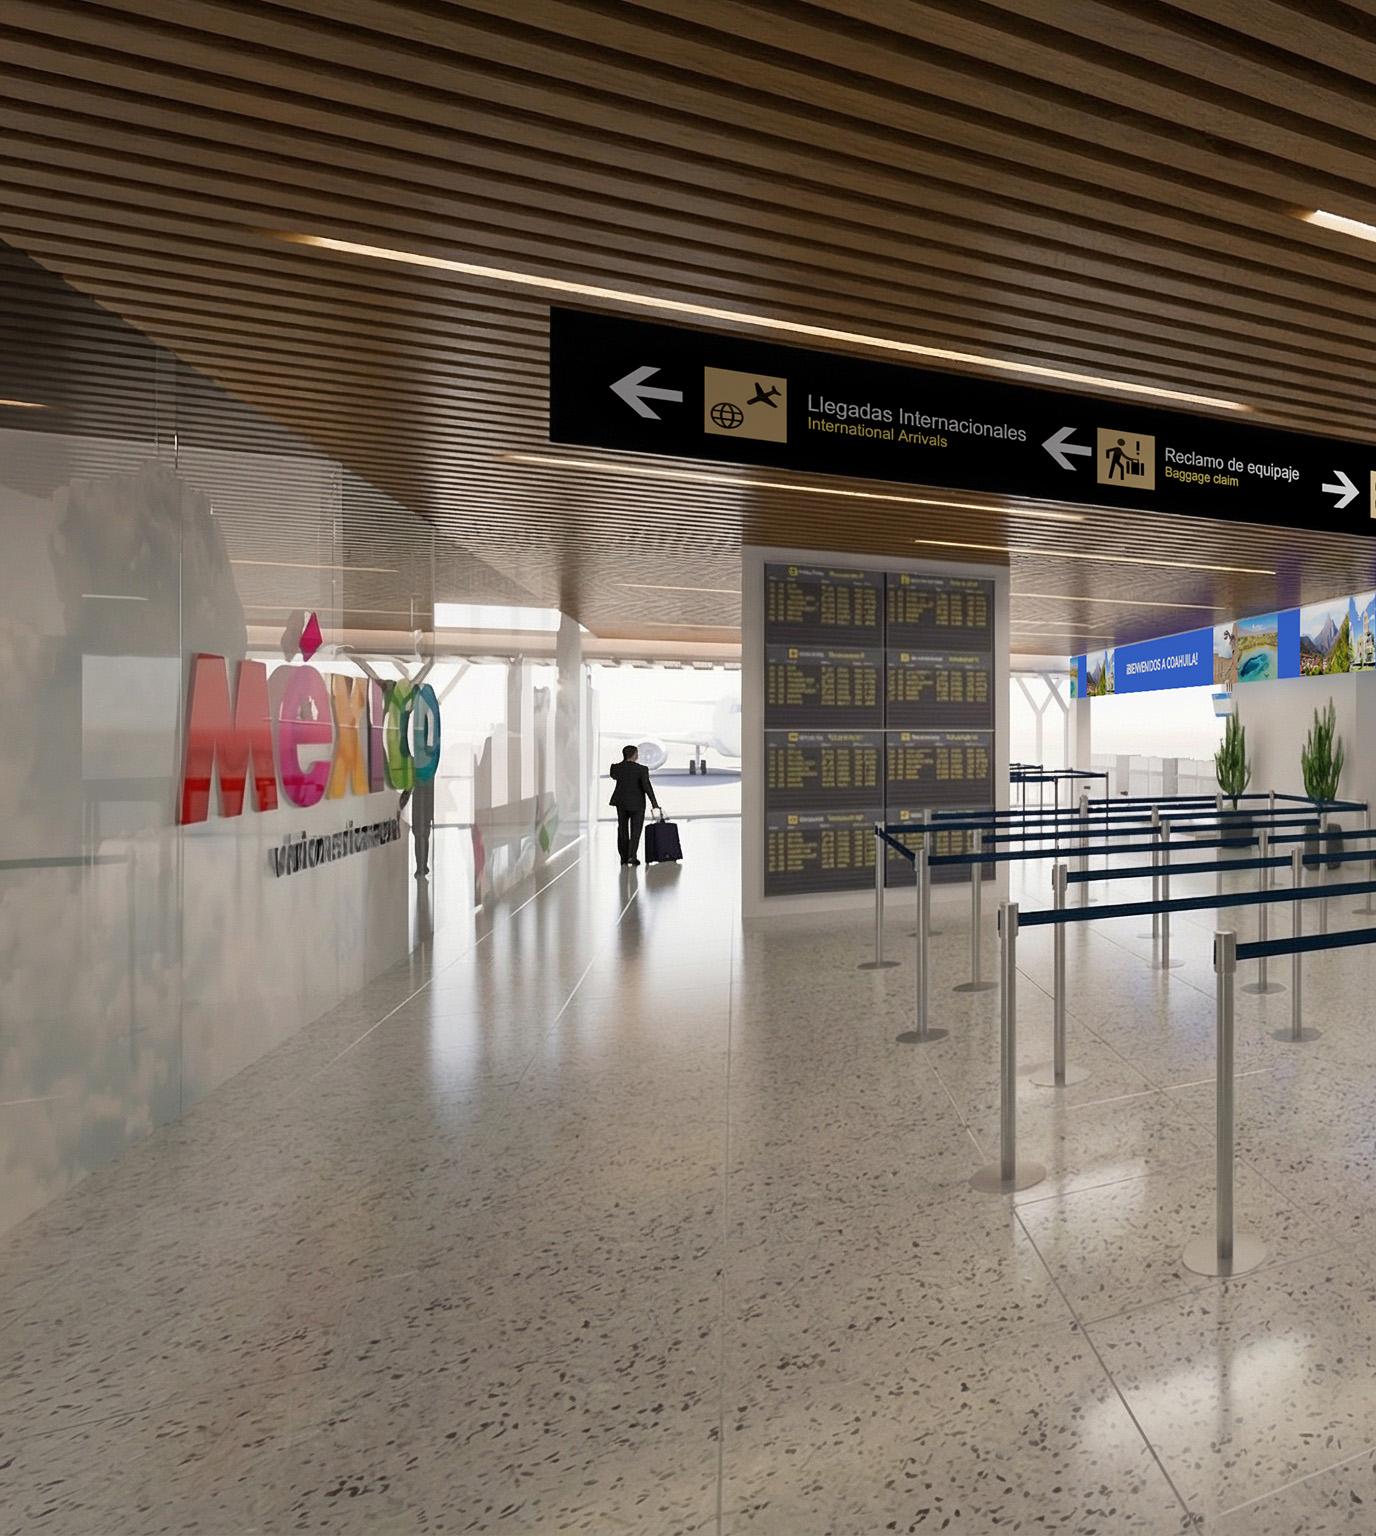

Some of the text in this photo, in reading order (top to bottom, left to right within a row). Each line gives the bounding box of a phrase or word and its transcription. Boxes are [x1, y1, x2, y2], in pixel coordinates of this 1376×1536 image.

[808, 394, 1027, 442] Llegadas Internacionales
[808, 416, 948, 447] International Arrivals
[1165, 447, 1300, 482] Reclamo de equipaje
[1165, 466, 1239, 487] Baggage claim
[1161, 658, 1167, 670] A
[1166, 652, 1199, 669] COAHUILA!
